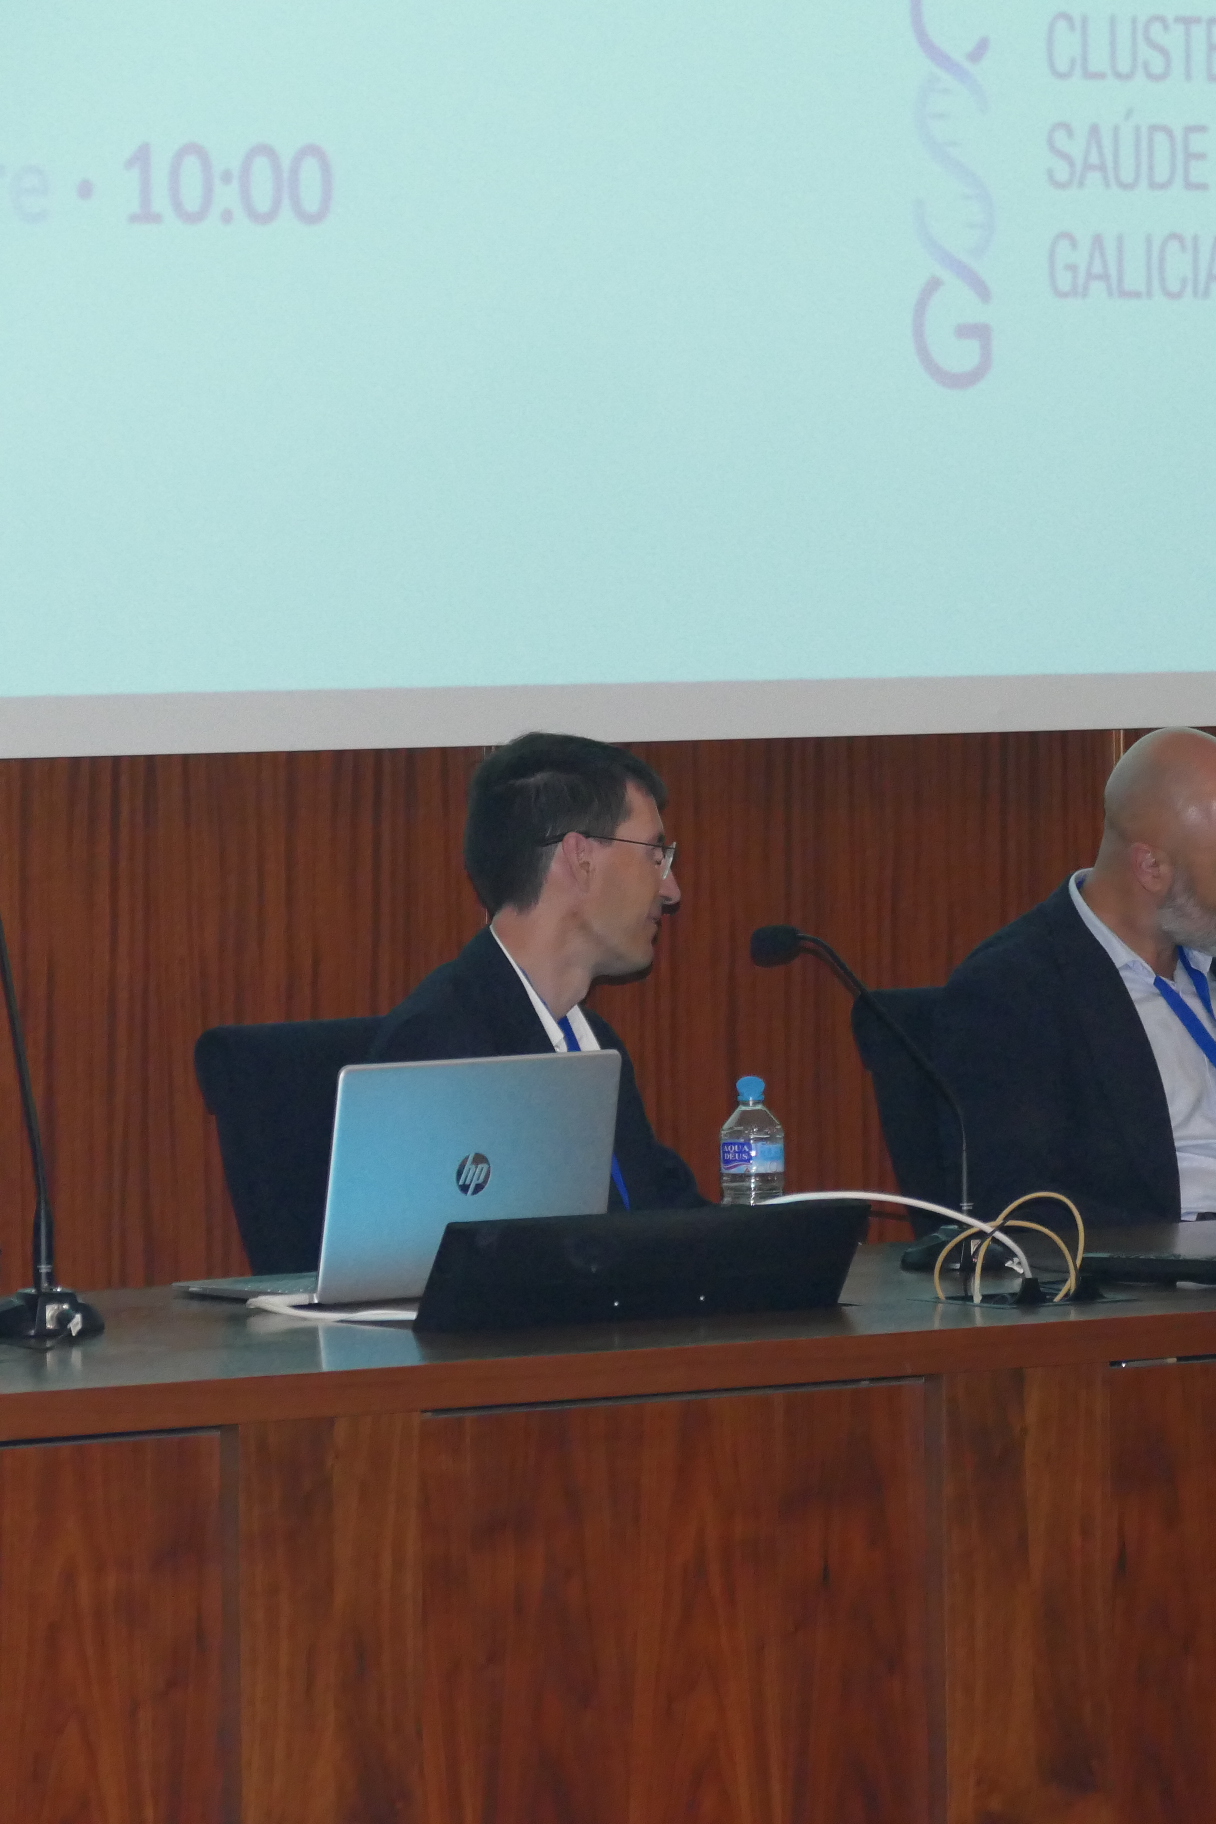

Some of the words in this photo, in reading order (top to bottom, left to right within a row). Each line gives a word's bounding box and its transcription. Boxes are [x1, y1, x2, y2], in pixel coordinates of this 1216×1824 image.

[1046, 108, 1210, 192] SAÚDE
[122, 140, 334, 226] 10:00
[458, 1152, 491, 1196] hp
[723, 1144, 749, 1152] AQUA
